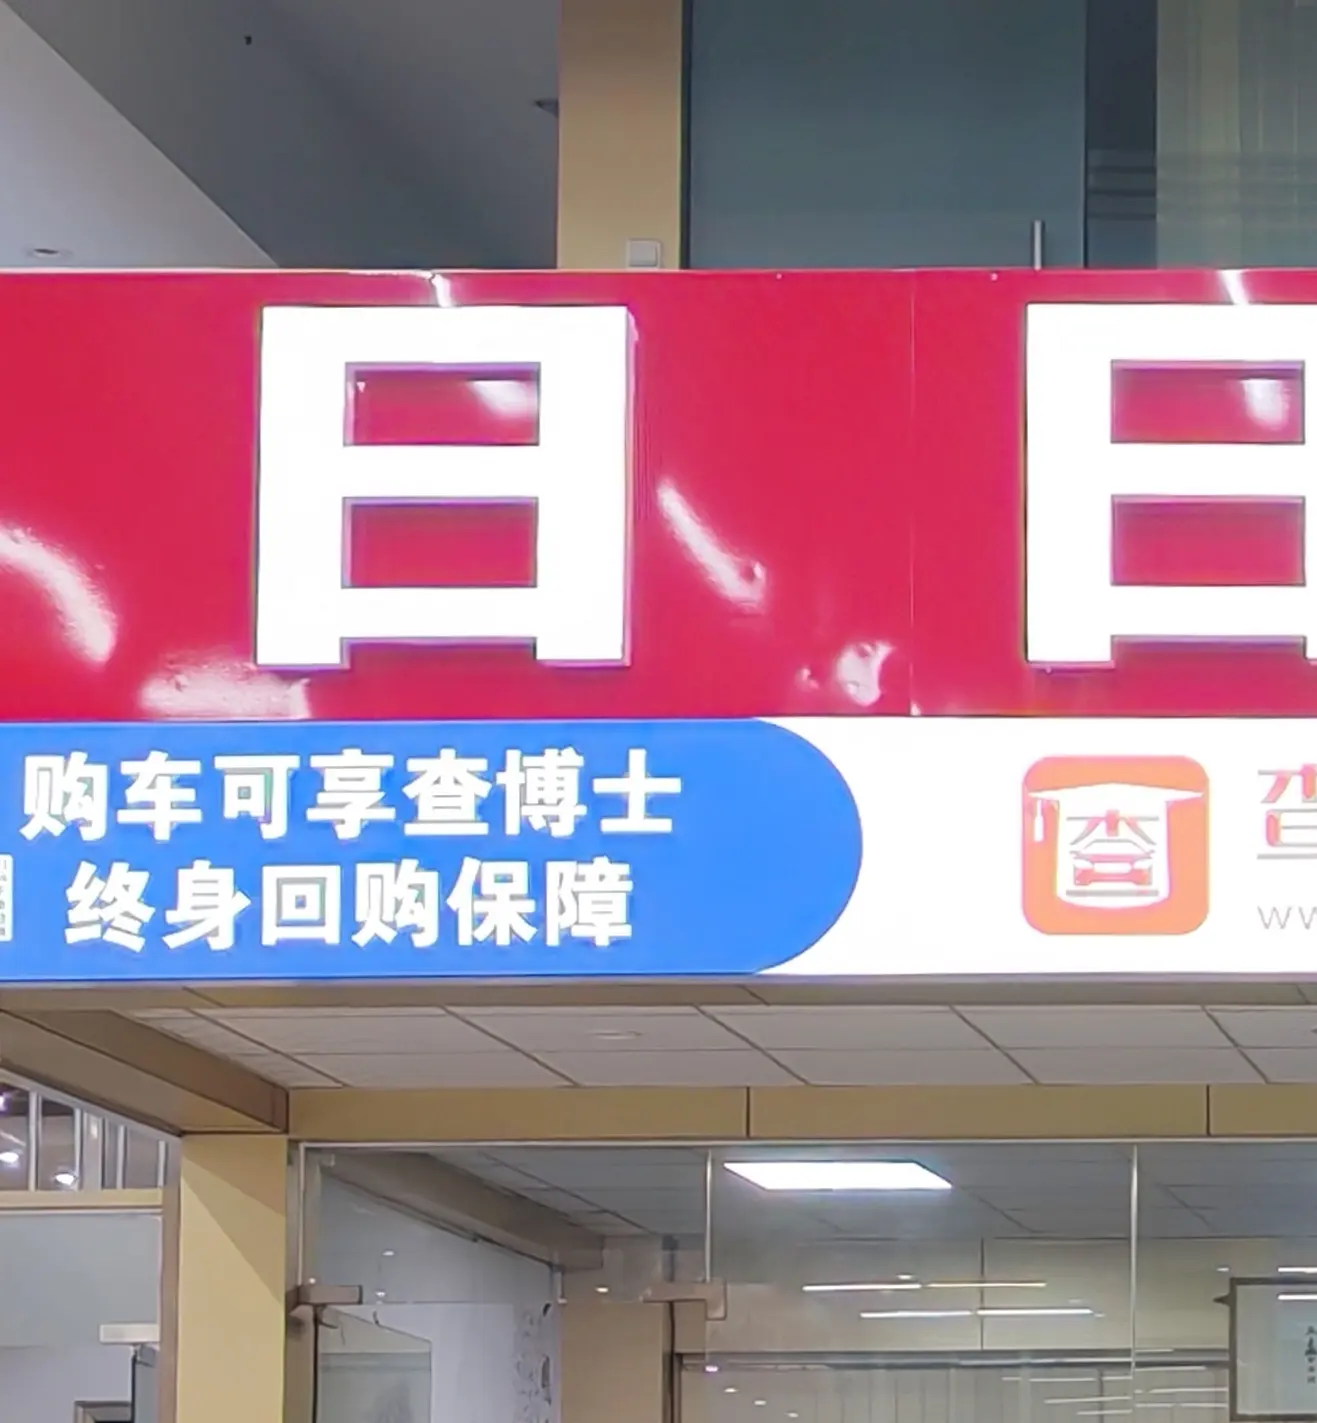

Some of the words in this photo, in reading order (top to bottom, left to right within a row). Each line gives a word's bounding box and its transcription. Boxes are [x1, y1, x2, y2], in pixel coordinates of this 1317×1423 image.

[20, 747, 682, 841] 购车可享查博士
[65, 856, 634, 952] 终身回购保障
